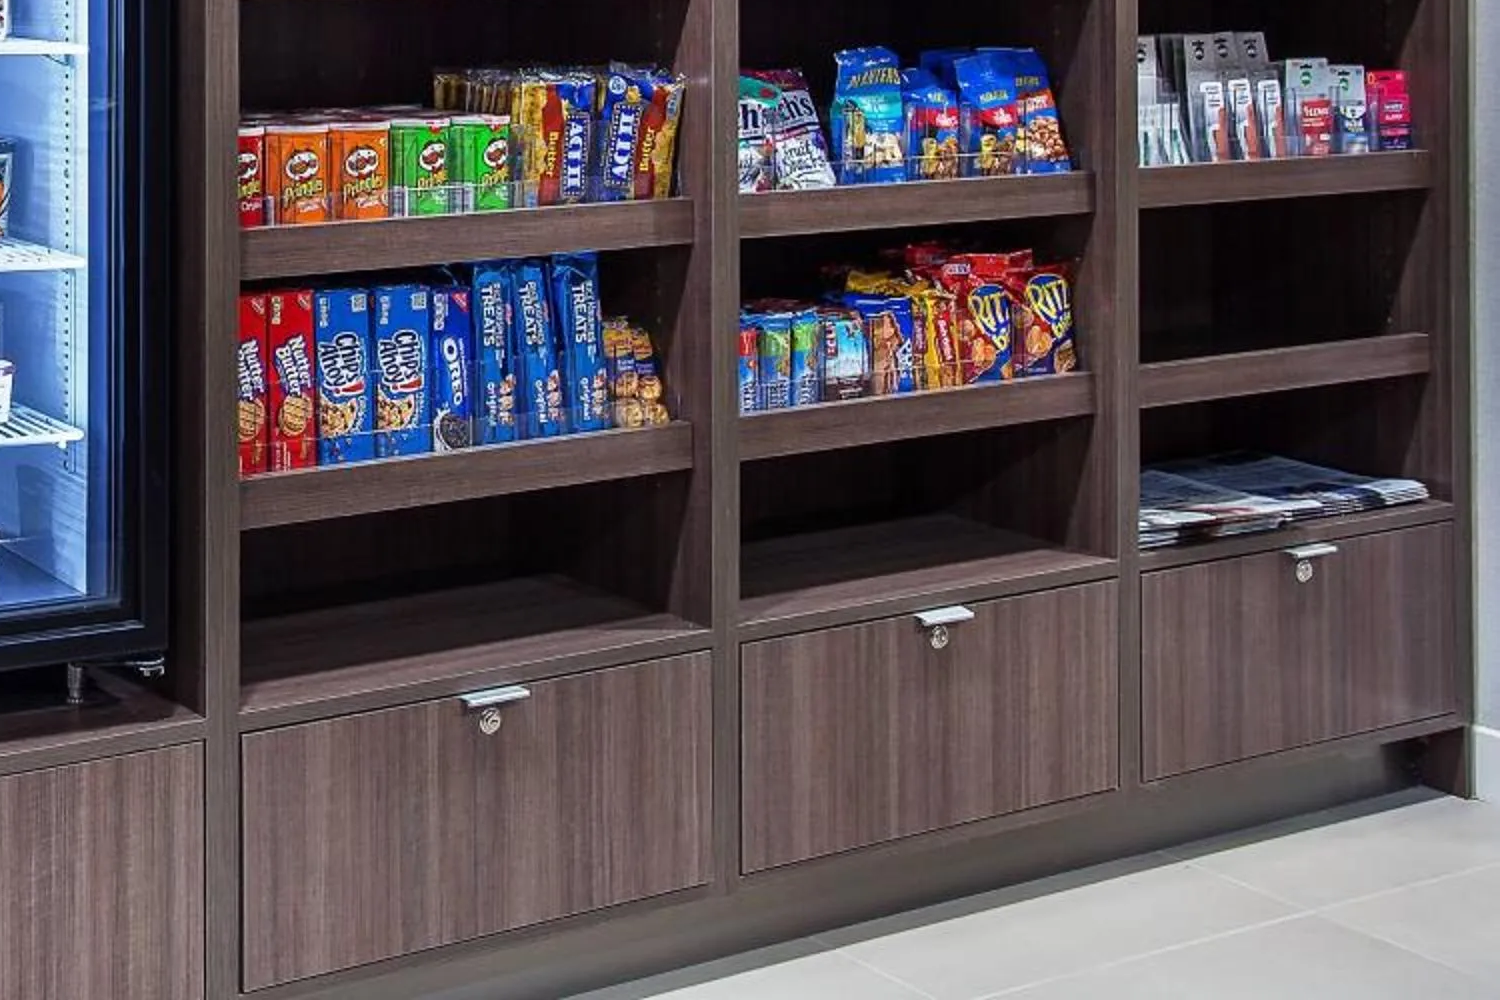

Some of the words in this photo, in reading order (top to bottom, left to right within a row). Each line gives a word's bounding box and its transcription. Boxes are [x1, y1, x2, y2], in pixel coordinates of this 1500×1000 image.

[567, 121, 583, 162] ACT
[618, 111, 635, 135] II
[638, 125, 656, 172] Butter
[545, 131, 560, 177] Butter
[567, 165, 582, 188] II
[611, 136, 633, 179] ACT
[481, 286, 496, 347] TREATS
[519, 284, 536, 345] TREATS
[572, 283, 587, 343] TREATS
[245, 339, 265, 394] Nutter
[276, 346, 300, 397] Butter
[287, 335, 311, 389] Nutter
[318, 341, 365, 396] Ahoy!
[333, 332, 362, 387] Chips
[378, 339, 423, 393] Ahoy!
[393, 330, 420, 385] Chips
[443, 337, 463, 407] OREO
